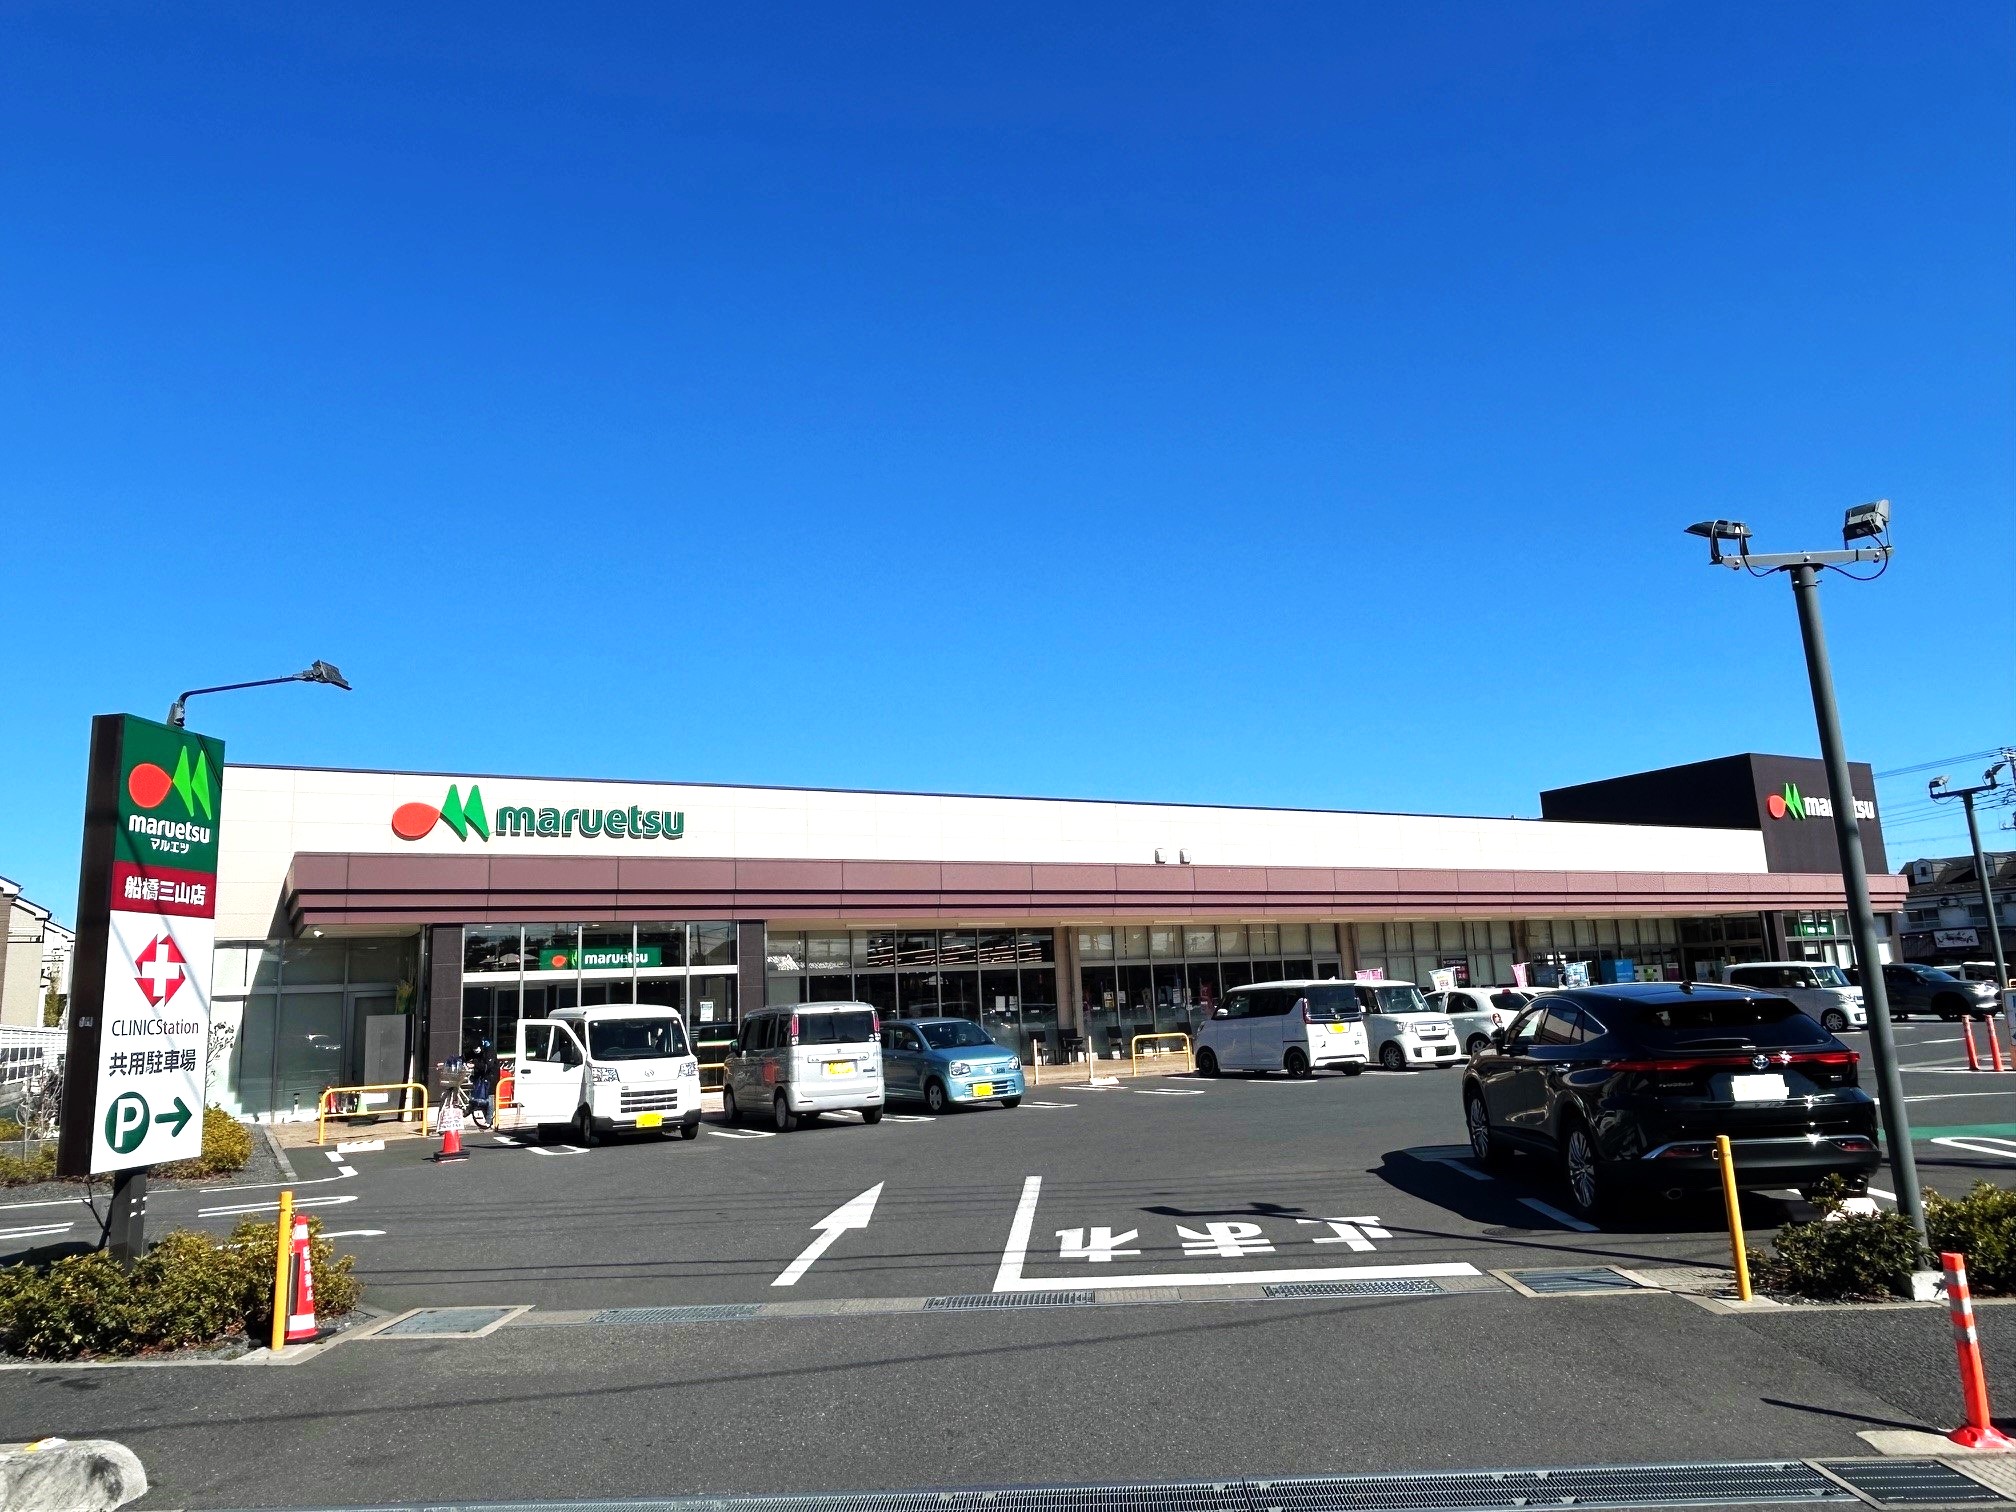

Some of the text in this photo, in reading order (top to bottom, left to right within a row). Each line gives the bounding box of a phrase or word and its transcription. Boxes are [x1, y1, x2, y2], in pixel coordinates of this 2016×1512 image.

[128, 814, 211, 844] maruetsu
[495, 804, 685, 841] maruetsu
[150, 837, 190, 854] マルエツ
[124, 875, 207, 906] 船橋三山店
[584, 951, 649, 965] maruetsu
[109, 1048, 197, 1078] 共用駐車場
[114, 1097, 145, 1148] P
[1054, 1214, 1394, 1263] 止まれ
